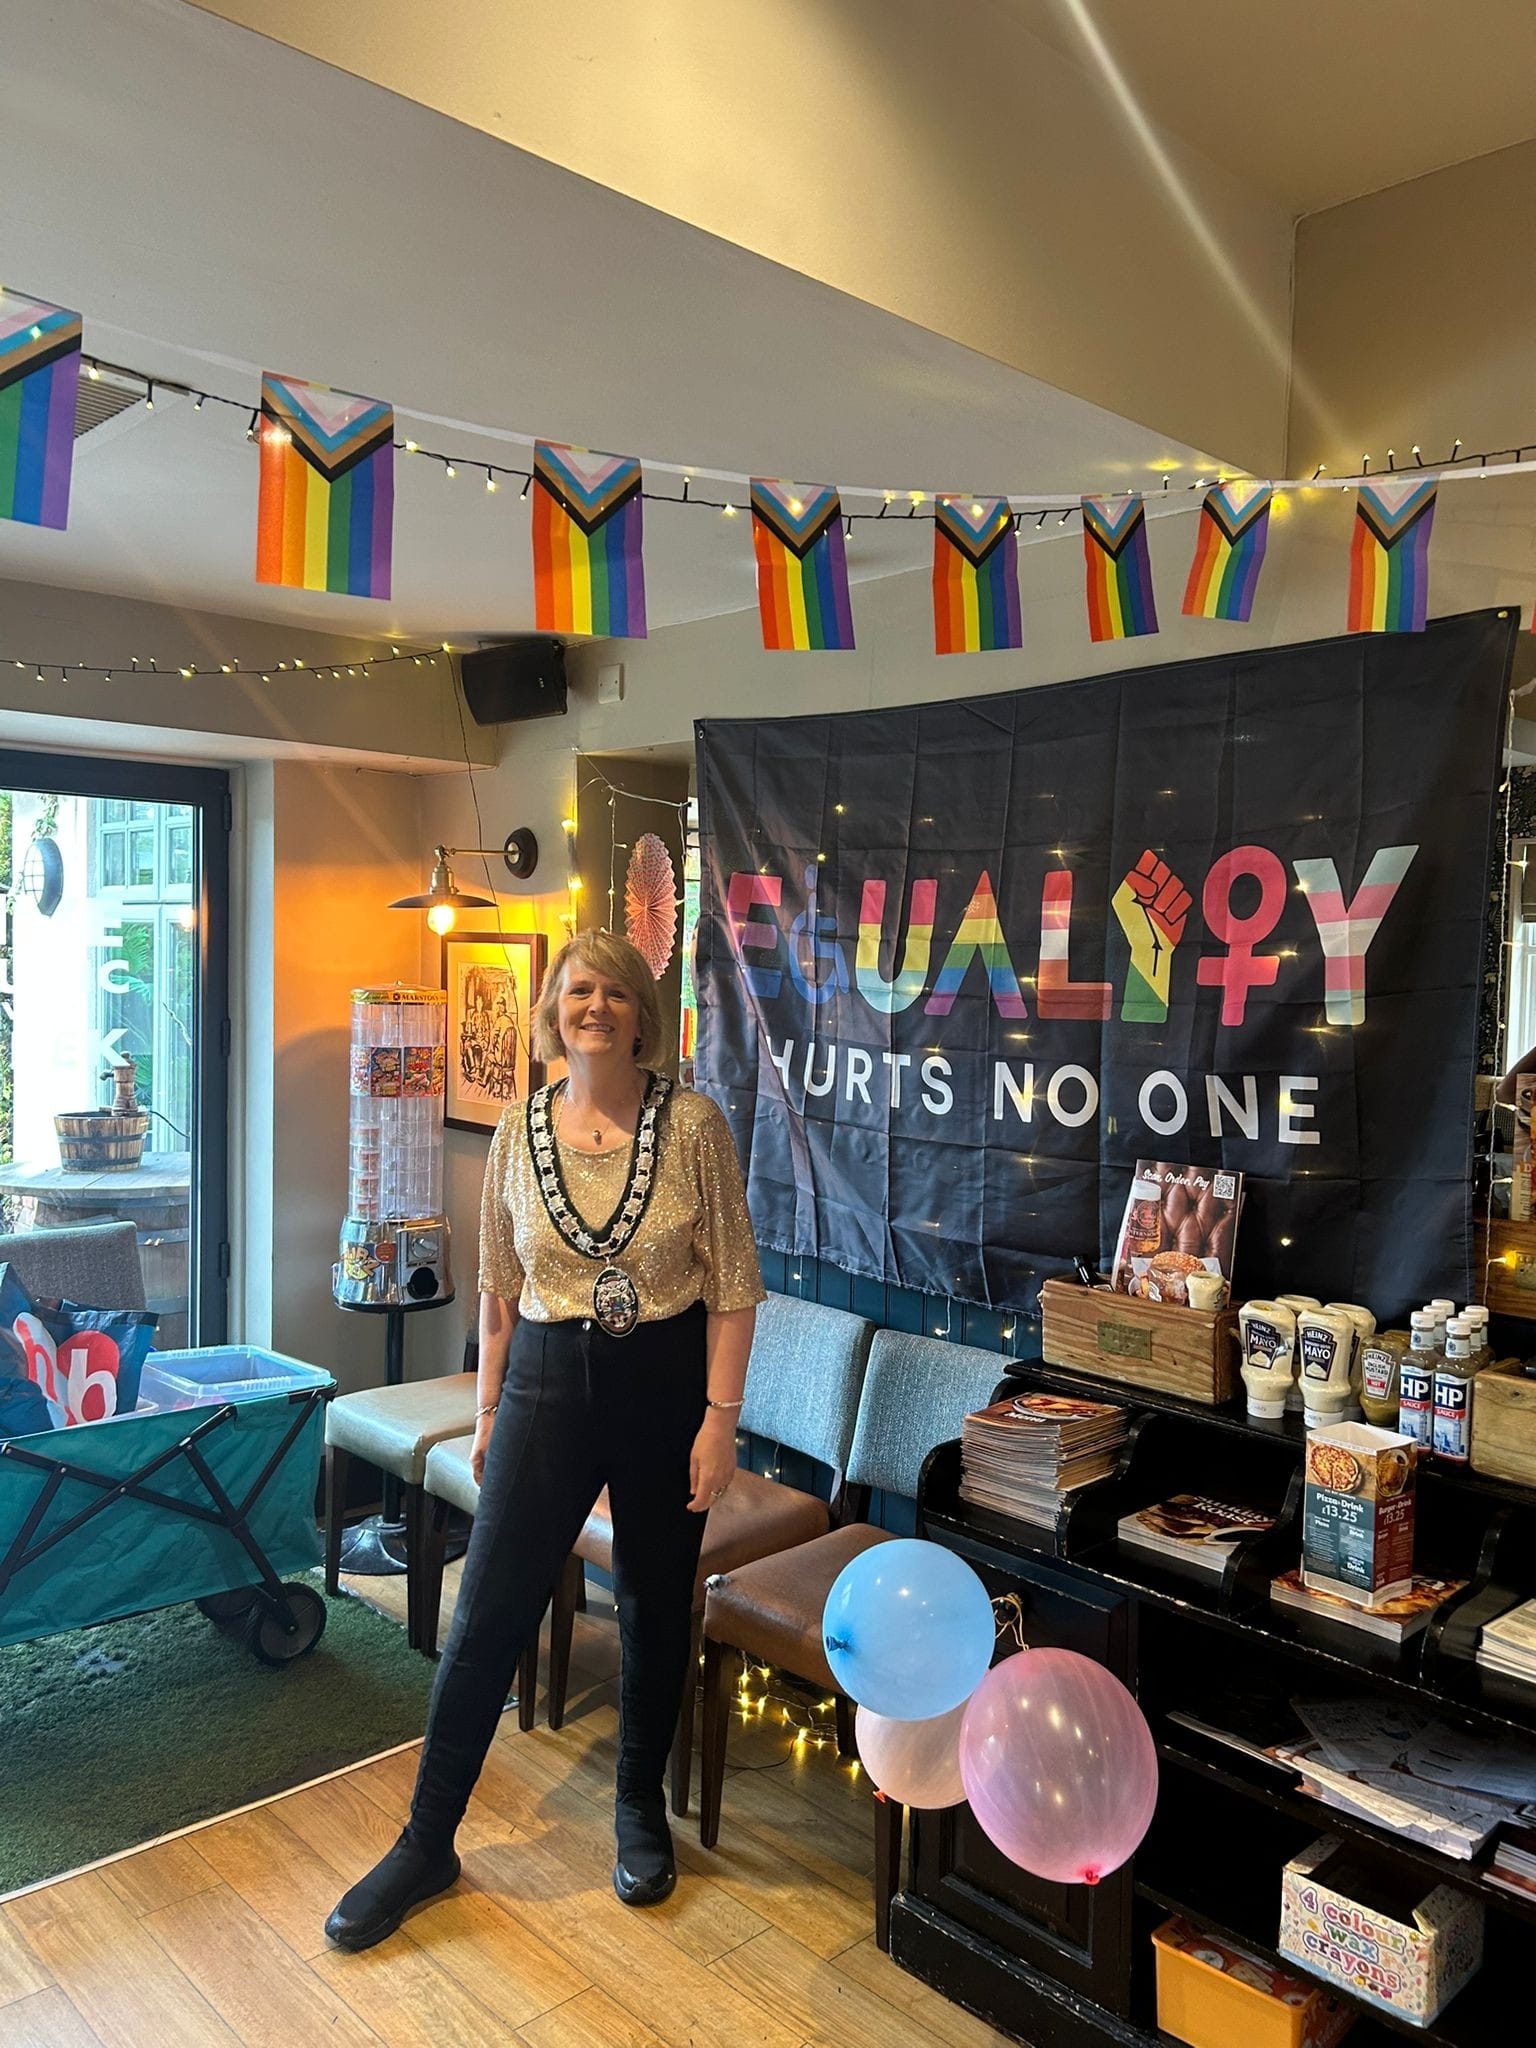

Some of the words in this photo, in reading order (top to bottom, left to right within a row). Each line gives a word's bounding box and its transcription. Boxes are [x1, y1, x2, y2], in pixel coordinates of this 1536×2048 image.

[765, 1035, 954, 1115] HURTS
[993, 1062, 1099, 1127] NO
[1138, 1070, 1321, 1145] ONE
[1250, 1333, 1277, 1349] MAYO
[1306, 1330, 1329, 1342] HEINZ
[1304, 1345, 1331, 1360] MAYO
[1367, 1352, 1386, 1362] HEINZ
[1400, 1376, 1430, 1399] HP
[1435, 1382, 1464, 1408] HP
[1402, 1400, 1422, 1410] SAUCE
[1436, 1409, 1456, 1419] SAUCE
[1316, 1492, 1338, 1505] Pizza
[1341, 1499, 1364, 1513] Drink
[1302, 1889, 1317, 1912] 4
[1325, 1903, 1406, 1953] colour
[1326, 1921, 1379, 1962] wax
[1304, 1932, 1400, 1992] crayons
